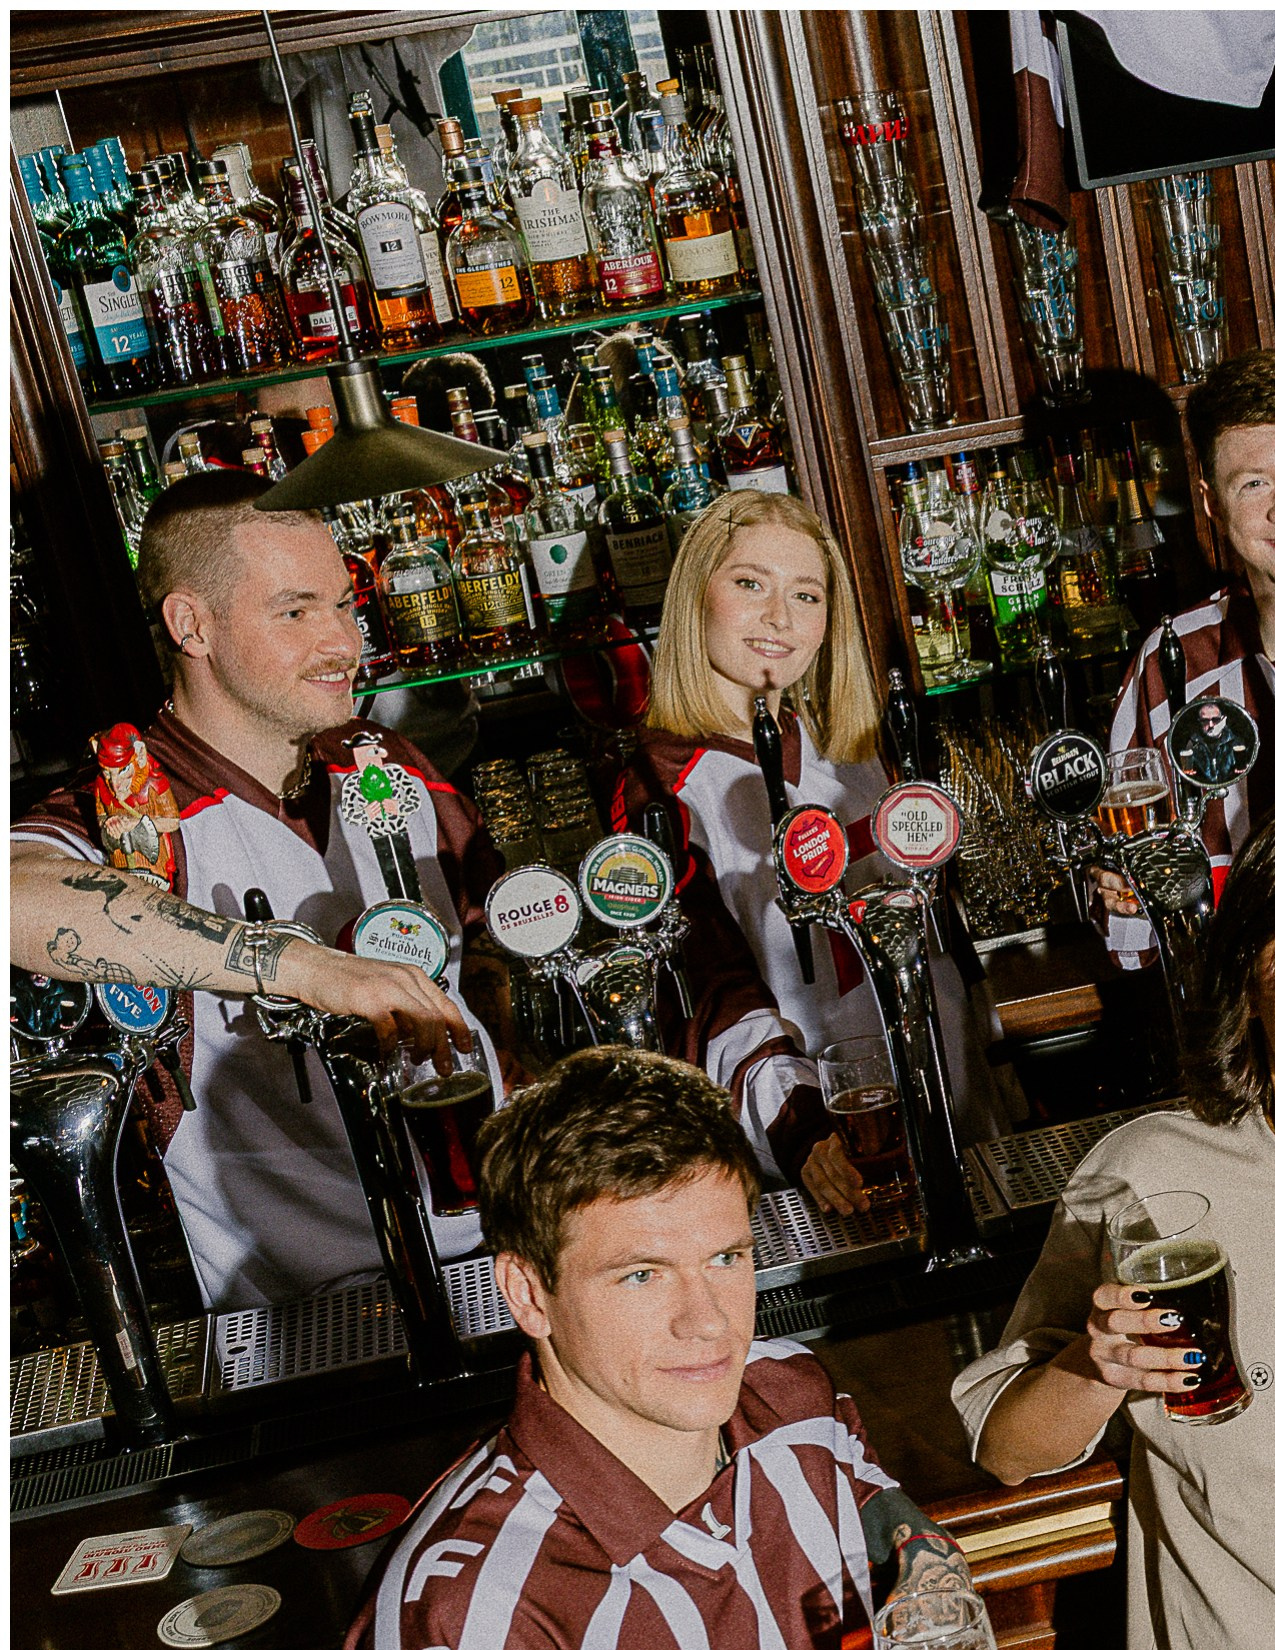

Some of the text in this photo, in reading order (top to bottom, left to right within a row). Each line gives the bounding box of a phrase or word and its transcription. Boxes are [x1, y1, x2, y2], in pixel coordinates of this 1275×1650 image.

[360, 211, 410, 229] BOWMORE
[523, 211, 581, 231] IRISHMAN
[541, 208, 559, 216] THE
[385, 242, 398, 251] 12
[604, 255, 653, 271] ABERLOUR
[500, 276, 513, 289] 12
[604, 279, 618, 292] 12
[112, 335, 131, 354] 12
[741, 428, 750, 436] 12
[1040, 751, 1097, 791] BLACK
[1046, 768, 1099, 797] SCOTTISH STOUT
[892, 821, 943, 832] SPECKLED
[793, 830, 831, 859] LONDON
[801, 841, 829, 864] PRIDE
[593, 878, 659, 898] MAGNERS
[497, 899, 552, 925] ROUGE
[554, 895, 570, 913] 8
[513, 911, 554, 927] BRUXELLES
[109, 984, 142, 1019] FIVE
[404, 1538, 485, 1603] F
